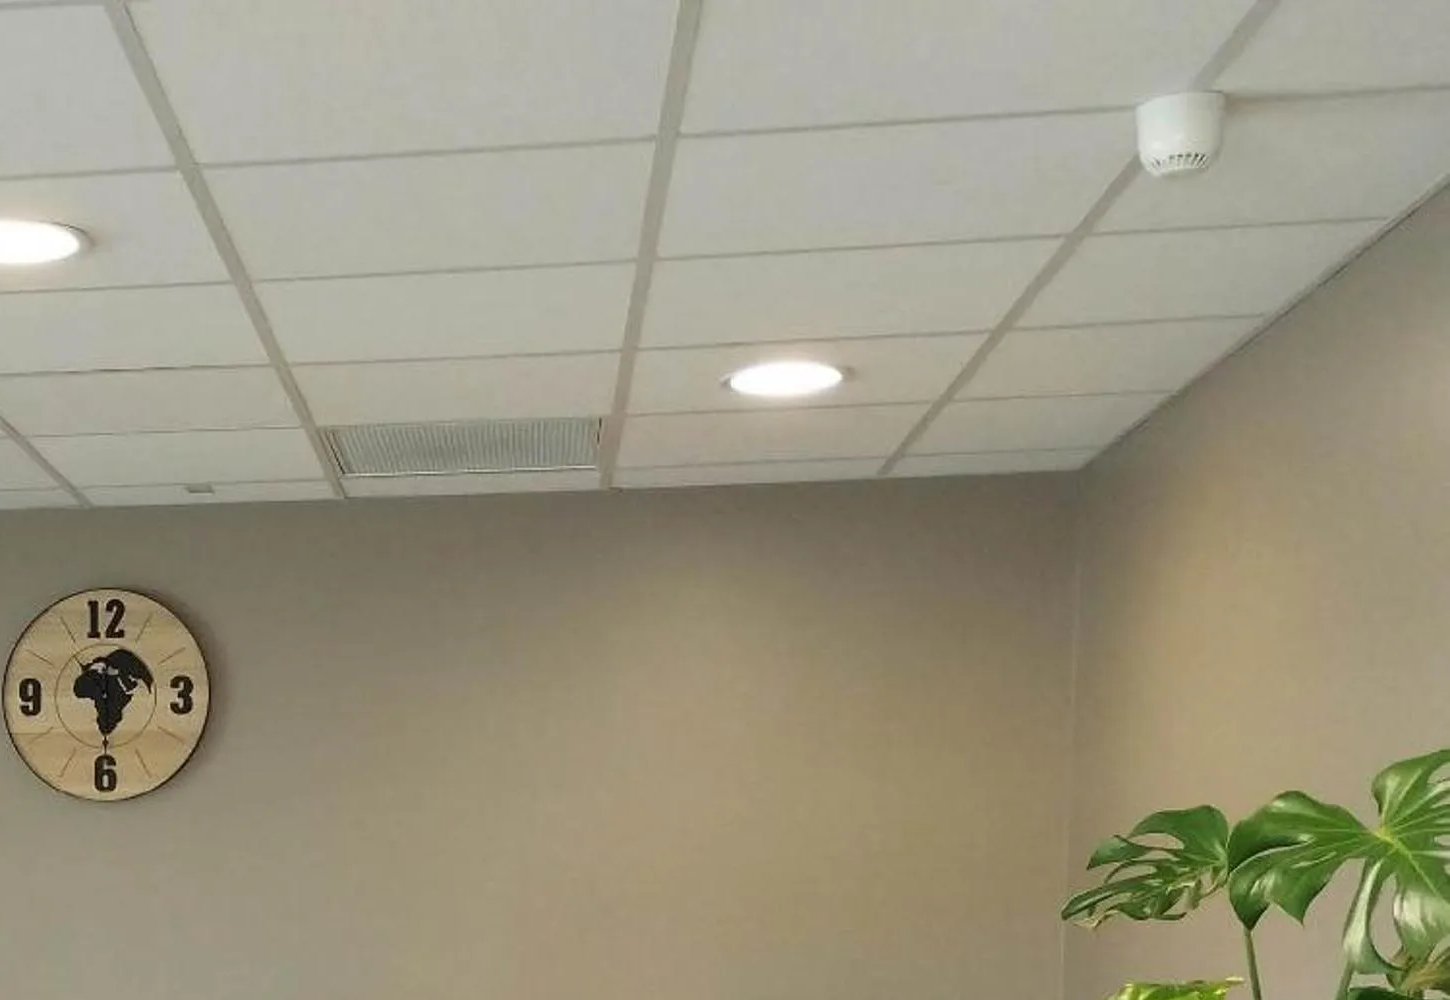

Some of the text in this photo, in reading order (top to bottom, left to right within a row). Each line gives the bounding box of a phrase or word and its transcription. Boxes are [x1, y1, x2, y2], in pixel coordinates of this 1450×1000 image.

[87, 599, 126, 639] 12
[18, 678, 42, 716] 9
[169, 675, 194, 715] 3
[94, 754, 117, 793] 6
